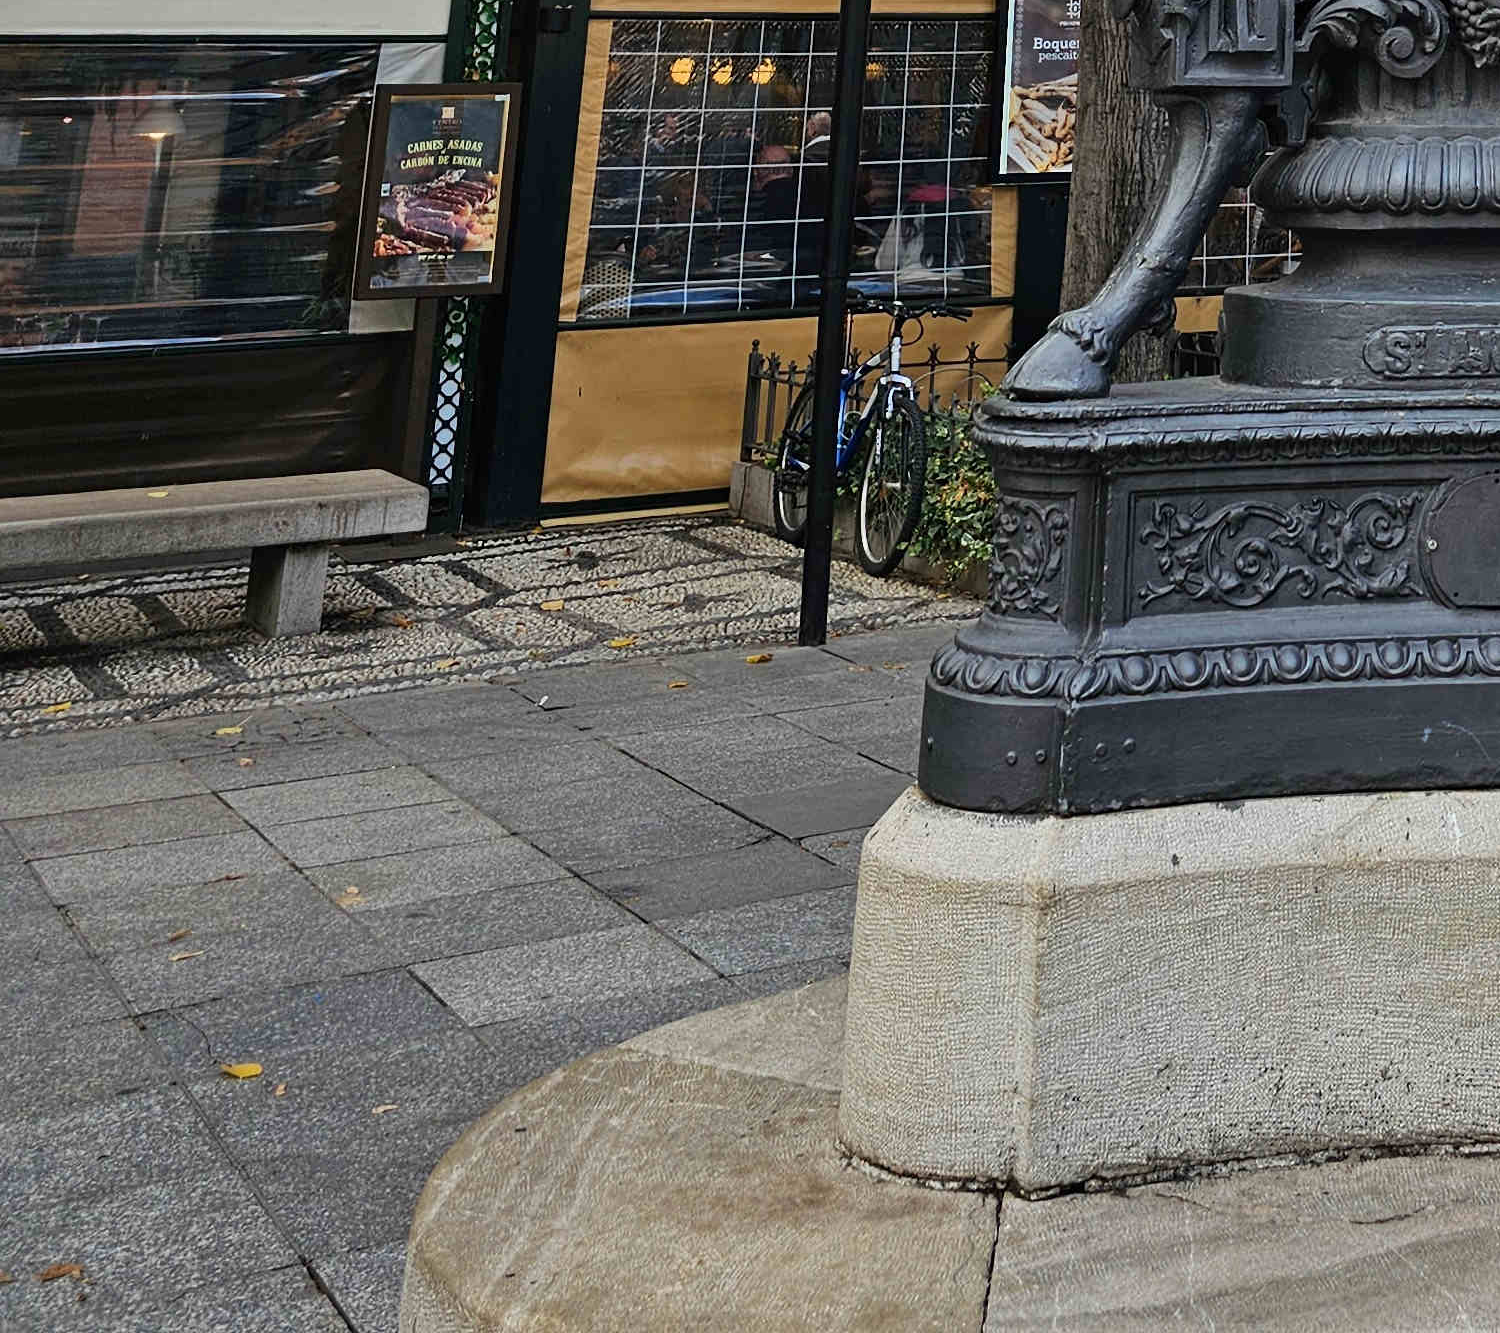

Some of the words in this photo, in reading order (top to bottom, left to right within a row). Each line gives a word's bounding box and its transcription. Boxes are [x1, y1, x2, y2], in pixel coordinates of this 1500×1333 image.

[407, 140, 444, 154] CARNES
[447, 139, 484, 153] ASADAS
[438, 155, 450, 165] DE
